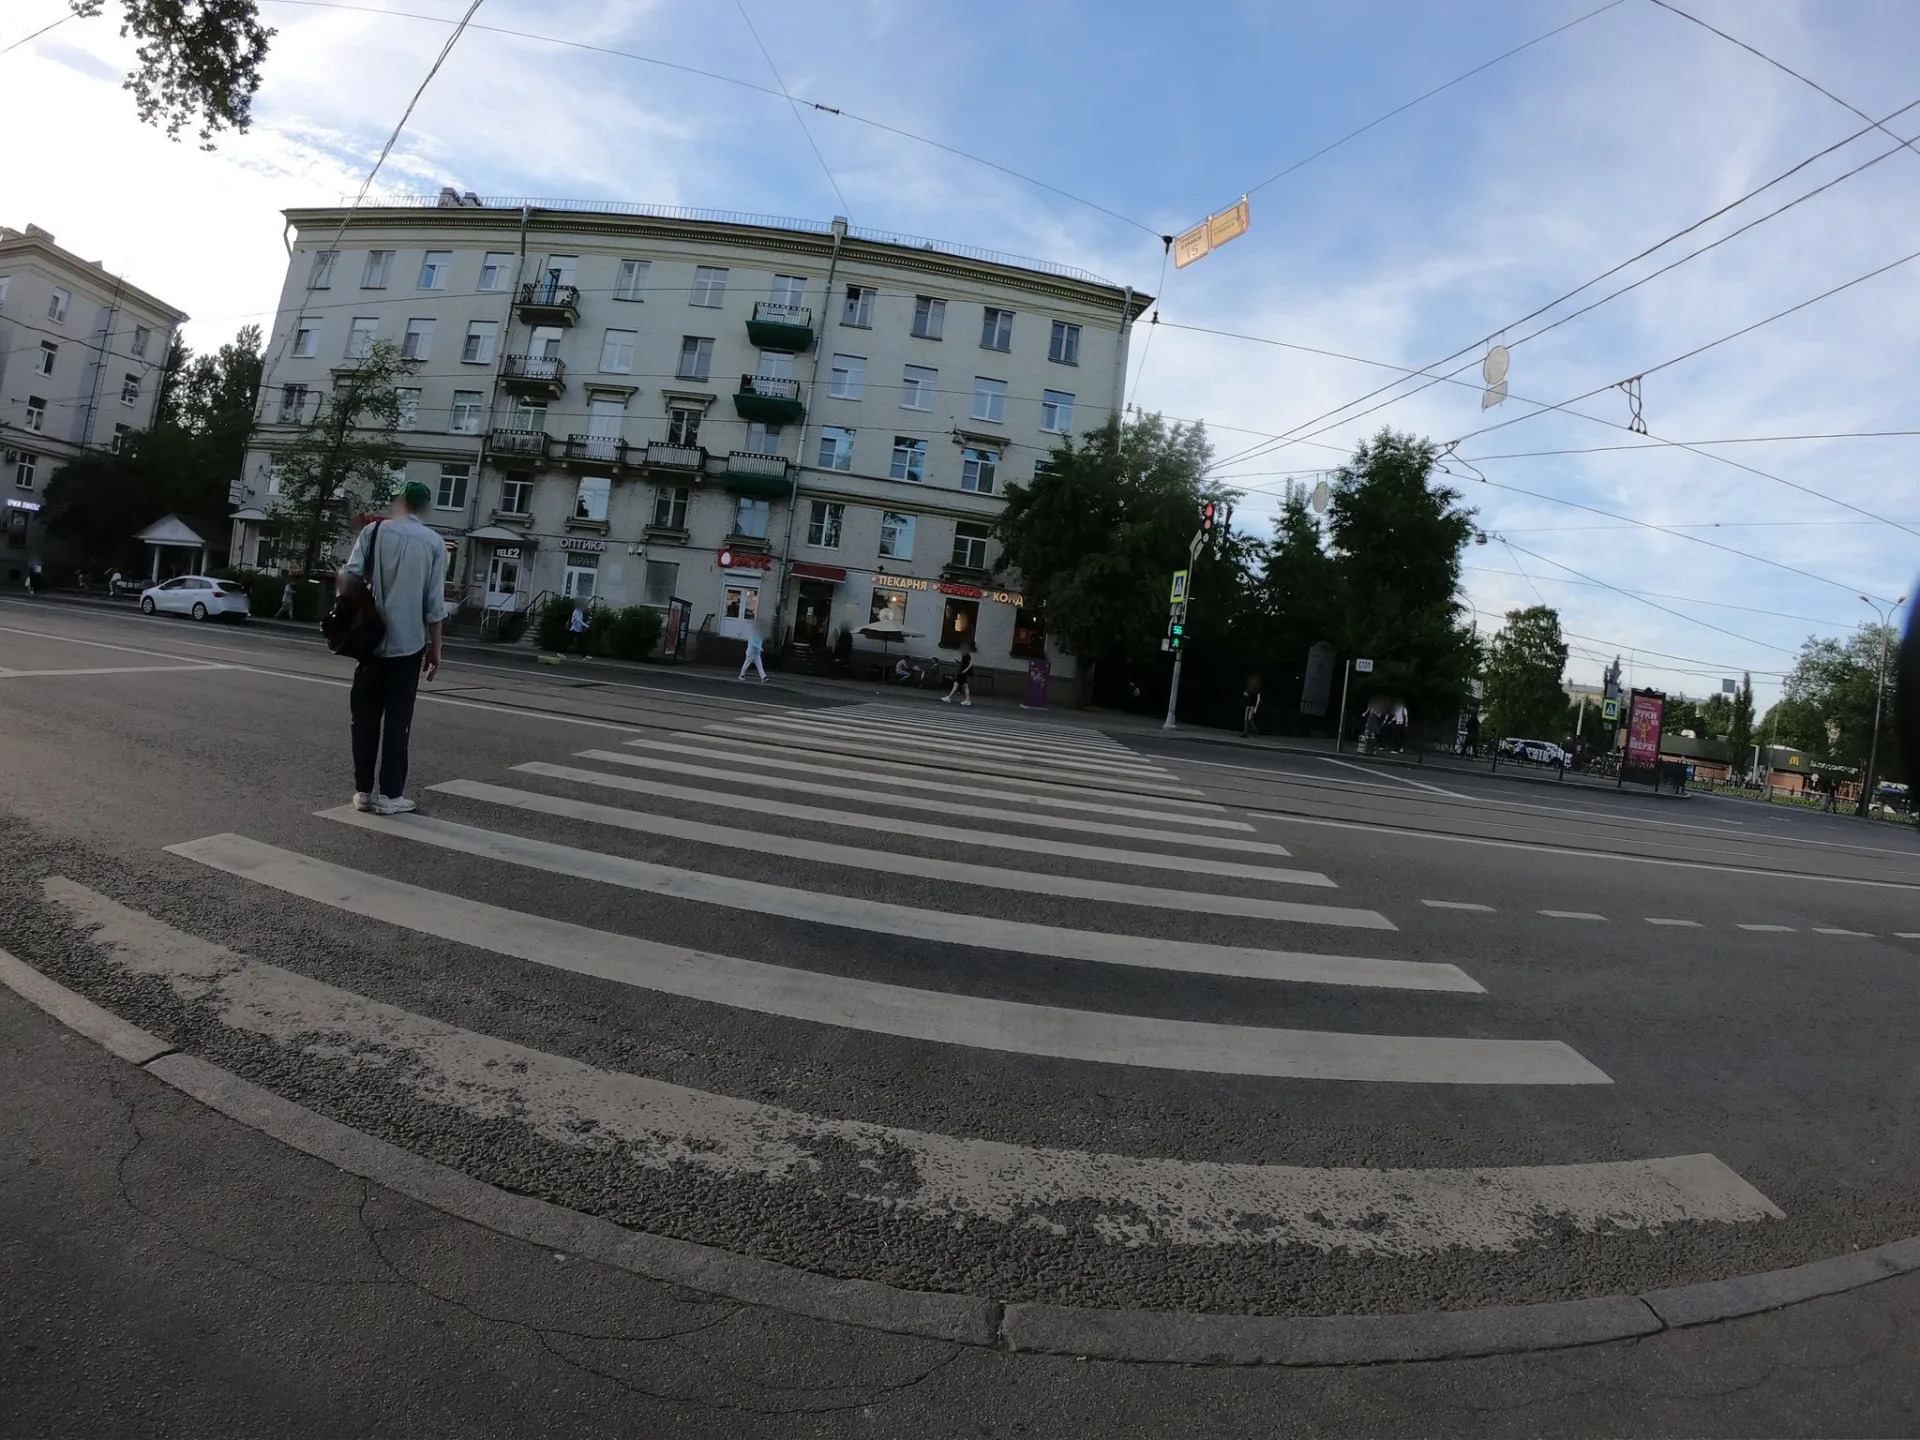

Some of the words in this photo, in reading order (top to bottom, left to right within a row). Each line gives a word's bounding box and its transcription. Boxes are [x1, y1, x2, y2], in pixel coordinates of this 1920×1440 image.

[560, 538, 606, 551] ОПТИКА
[496, 548, 519, 558] TELE2
[570, 555, 597, 566] ВРАЧ
[879, 575, 927, 591] ПЕКАРНЯ
[1635, 709, 1657, 720] РУКИ
[1629, 740, 1655, 752] ВВЕРХ!
